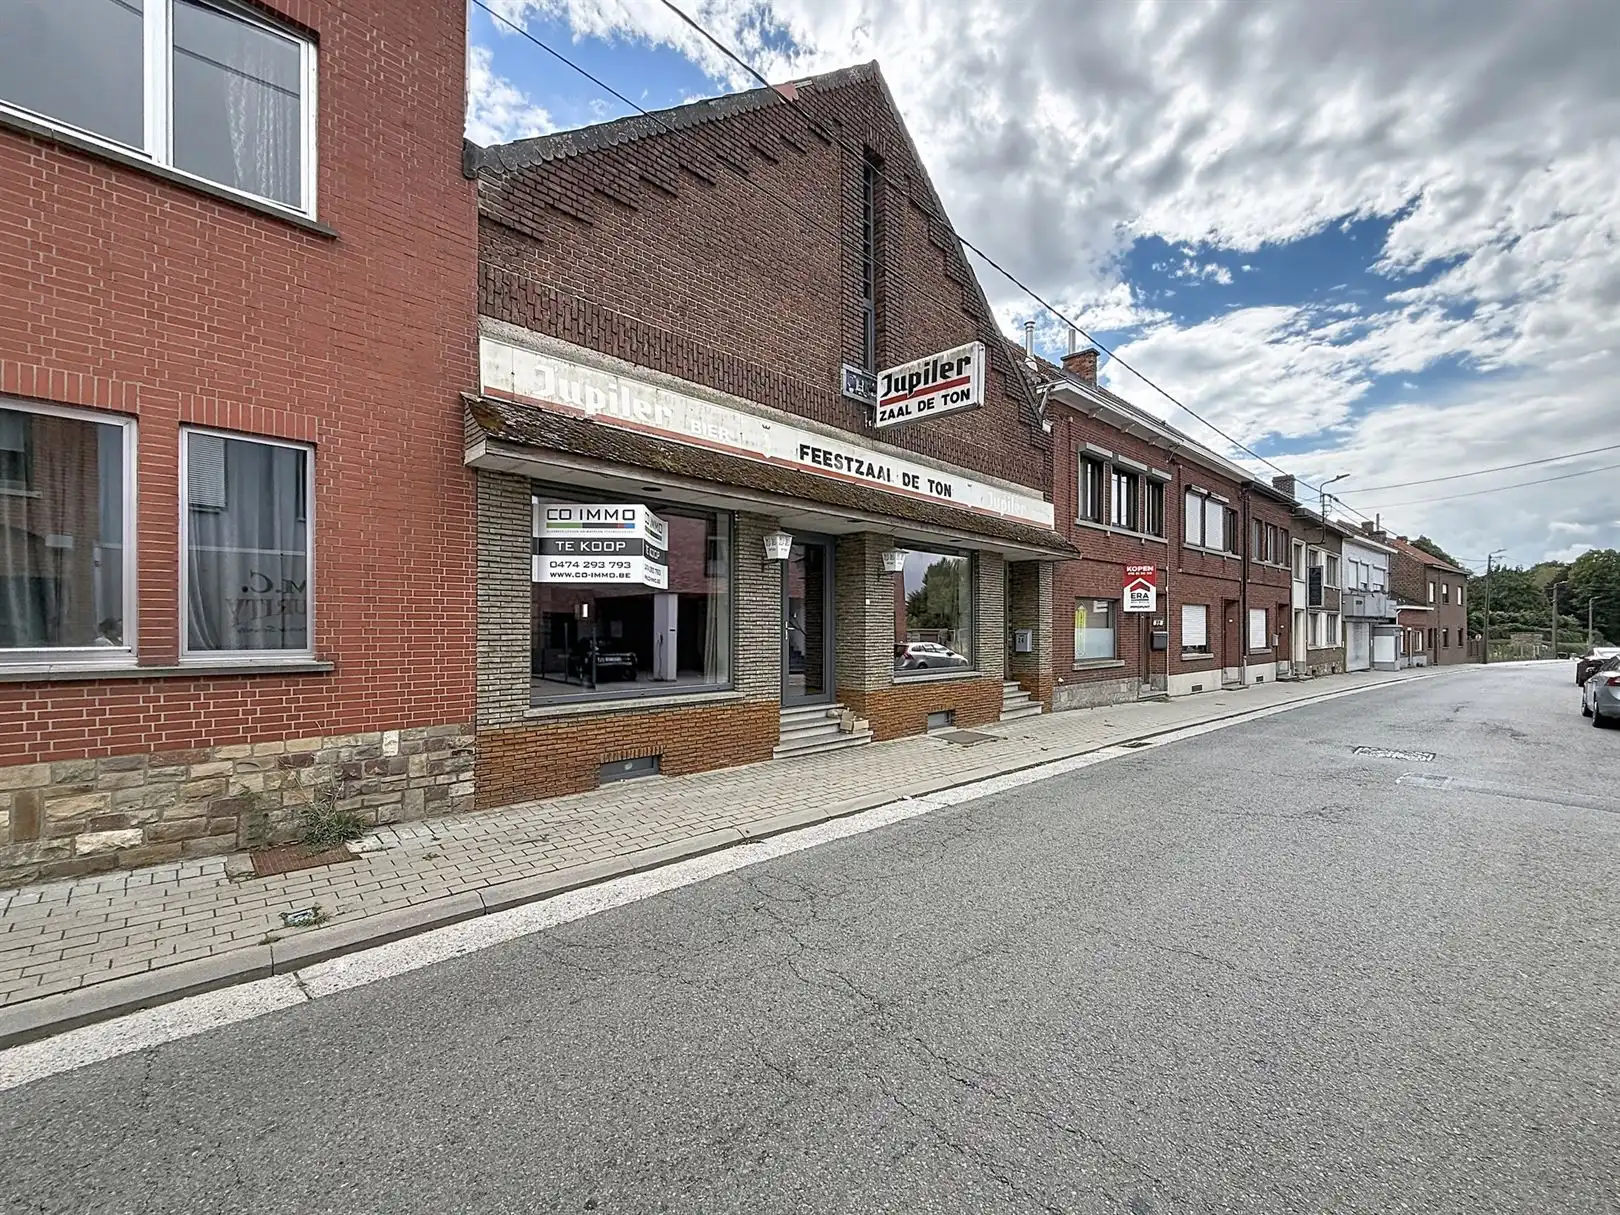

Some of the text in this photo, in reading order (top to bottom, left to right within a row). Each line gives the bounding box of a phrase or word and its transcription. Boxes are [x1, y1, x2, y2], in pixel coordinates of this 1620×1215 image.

[881, 356, 971, 398] Jupiler
[879, 388, 971, 422] ZAAL DE TON
[902, 472, 920, 490] DE
[928, 478, 952, 498] TON
[546, 508, 636, 521] CO IMMO
[555, 541, 626, 552] TE KOOP
[549, 561, 632, 569] 0474 293 793
